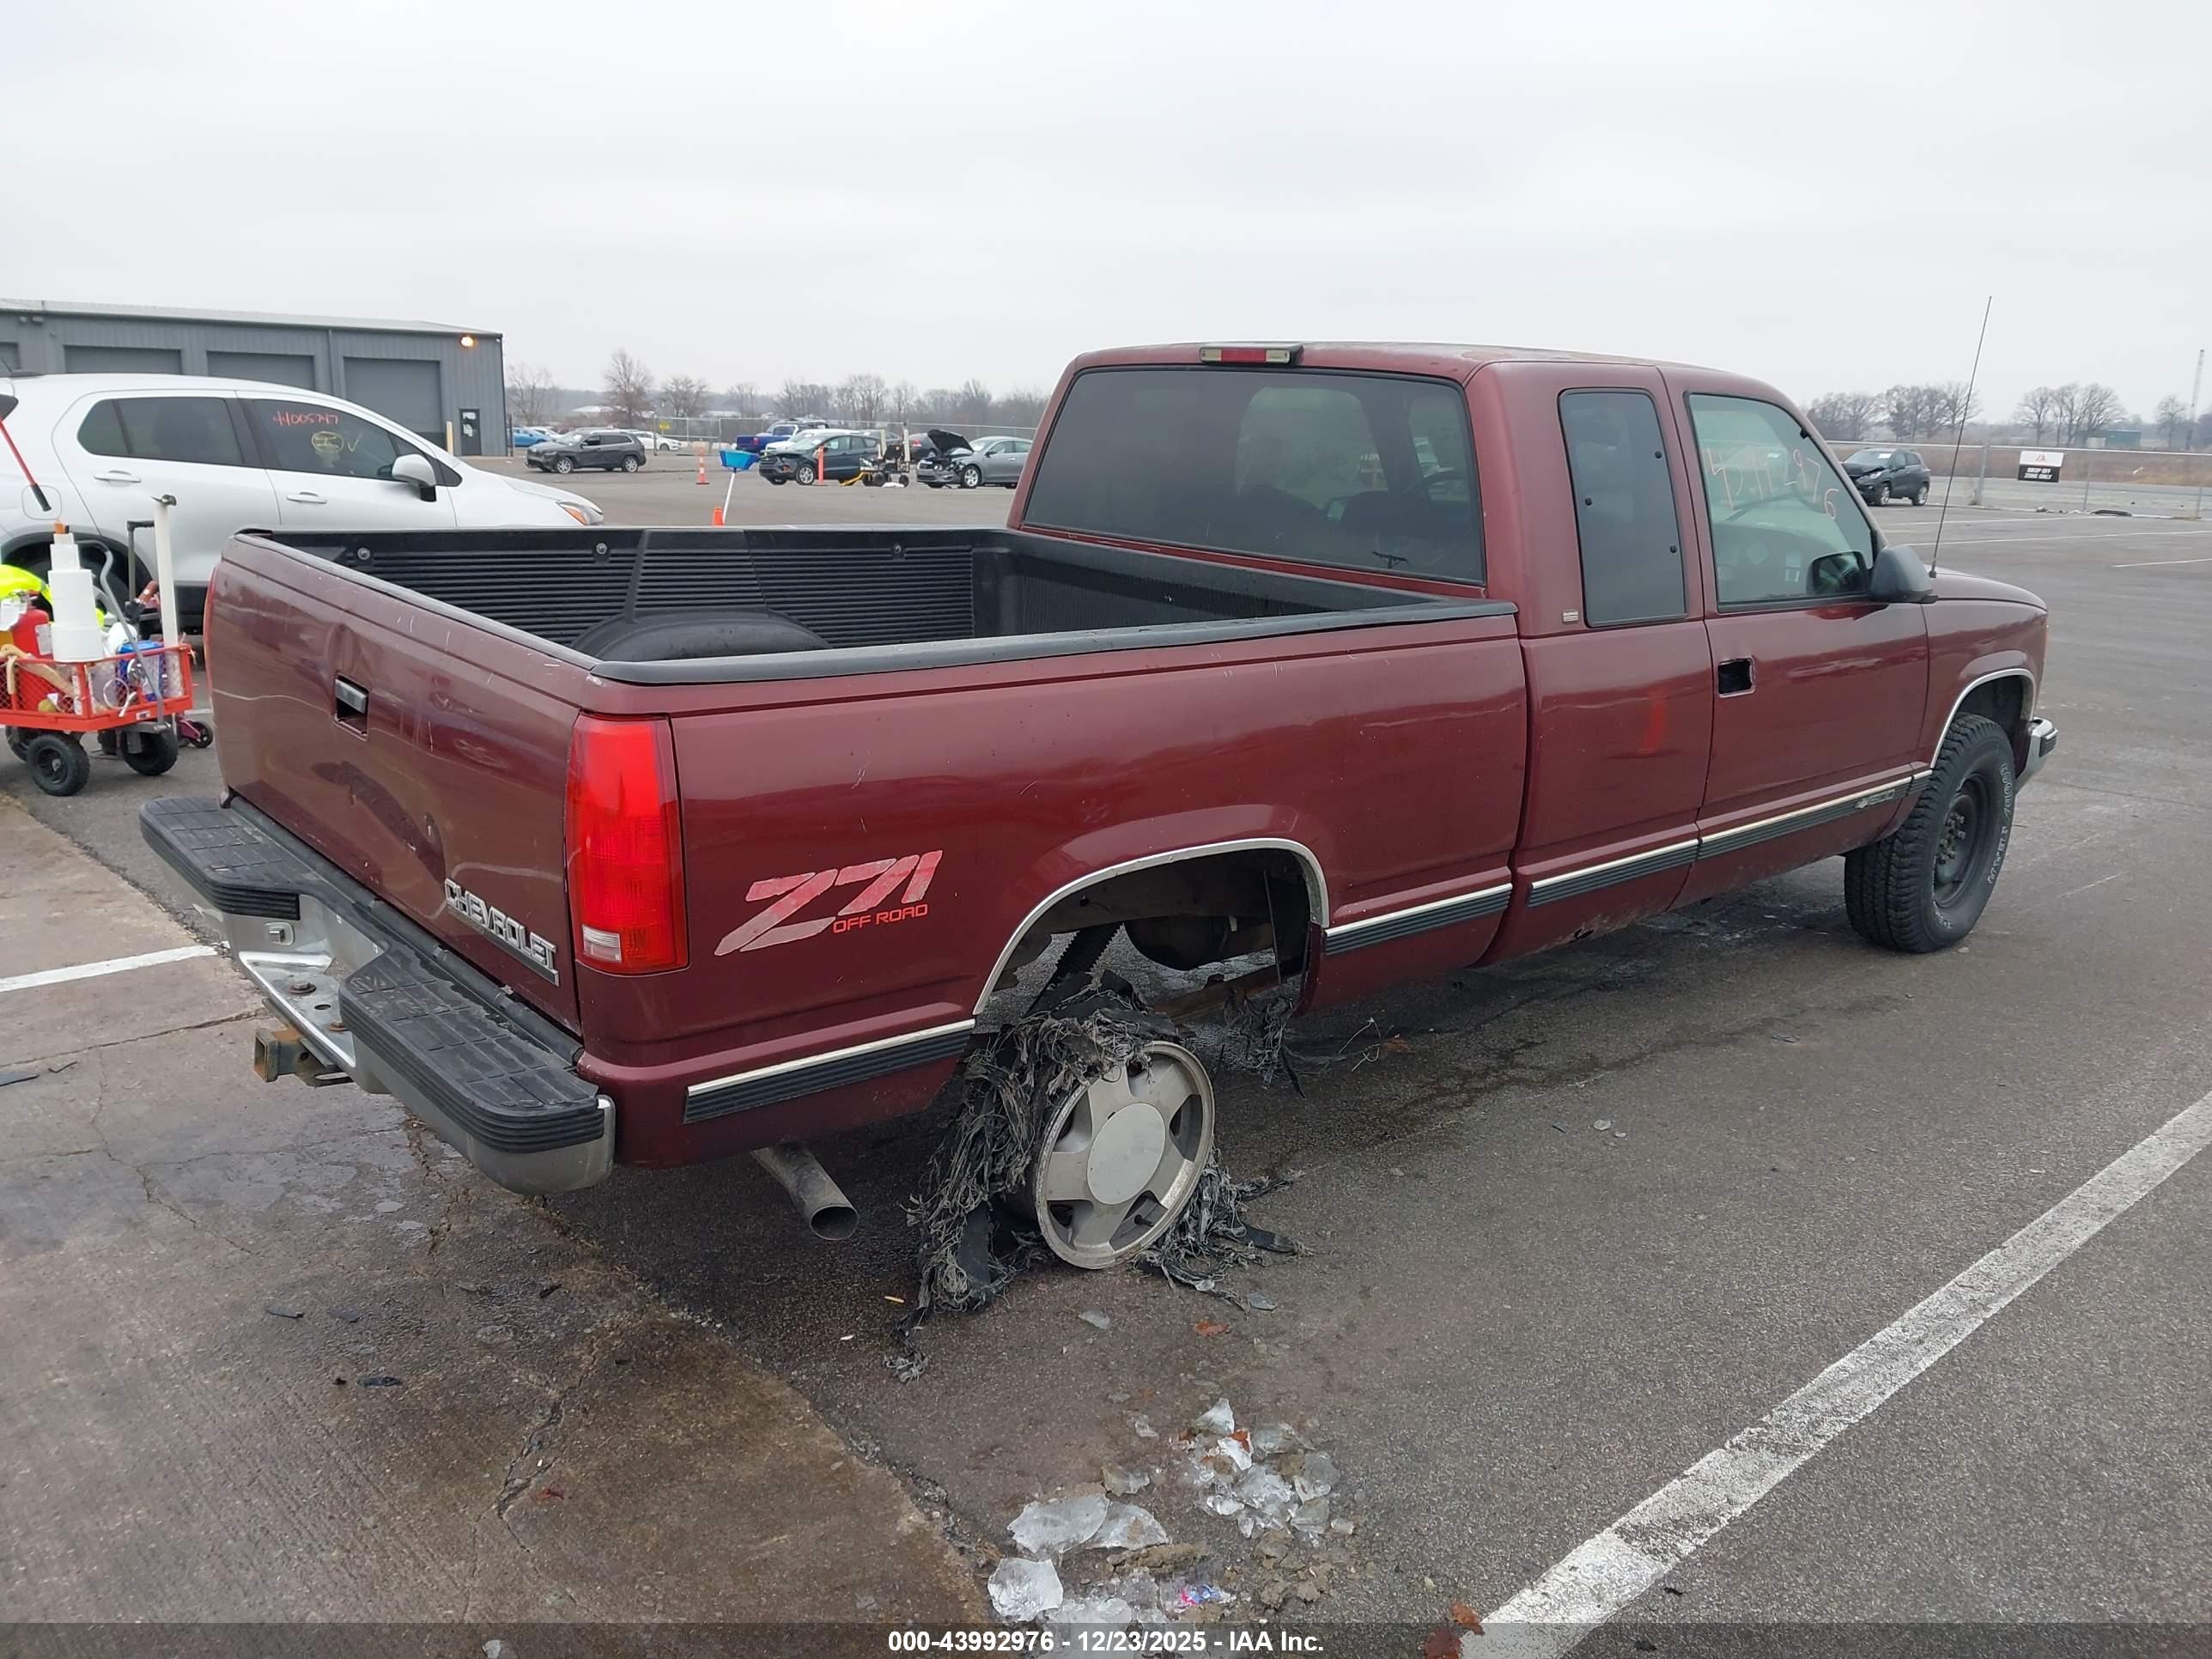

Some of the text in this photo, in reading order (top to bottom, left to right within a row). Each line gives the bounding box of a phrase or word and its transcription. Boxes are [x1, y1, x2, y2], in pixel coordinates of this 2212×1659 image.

[445, 878, 556, 971] CHEVROLET
[714, 850, 943, 956] Z71
[833, 904, 928, 933] OFF ROAD
